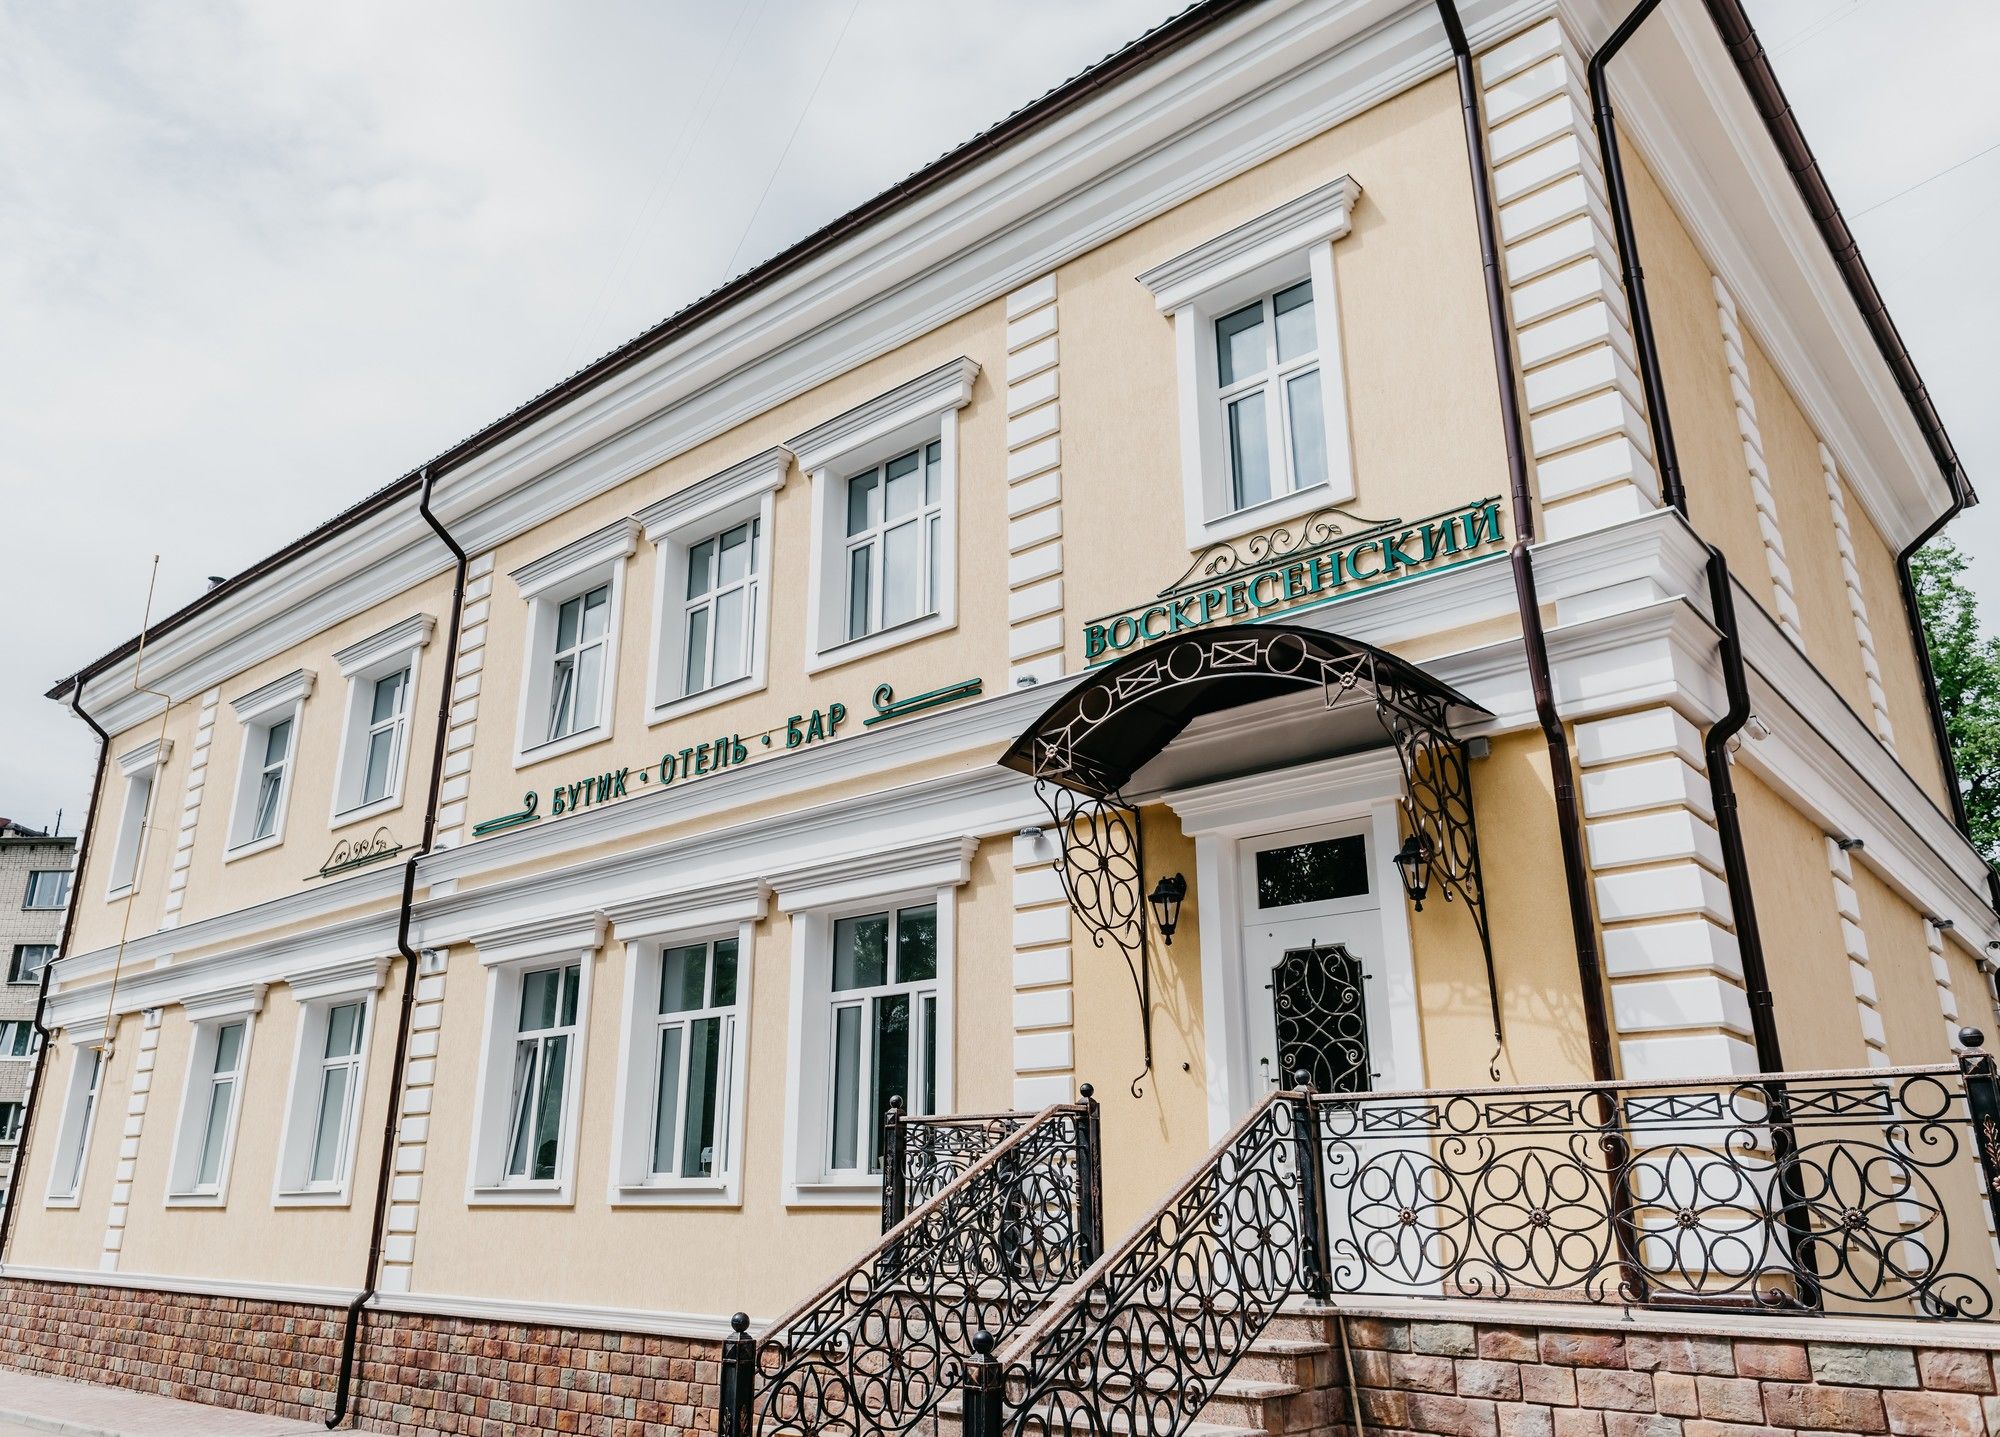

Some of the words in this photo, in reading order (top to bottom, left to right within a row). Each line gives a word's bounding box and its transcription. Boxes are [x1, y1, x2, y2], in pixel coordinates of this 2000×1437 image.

[1084, 498, 1505, 660] ВОСКРЕСЕНСКИЙ
[551, 767, 629, 816] БУТИК
[659, 733, 748, 784] ОТЕЛЬ
[786, 702, 847, 749] БАР
